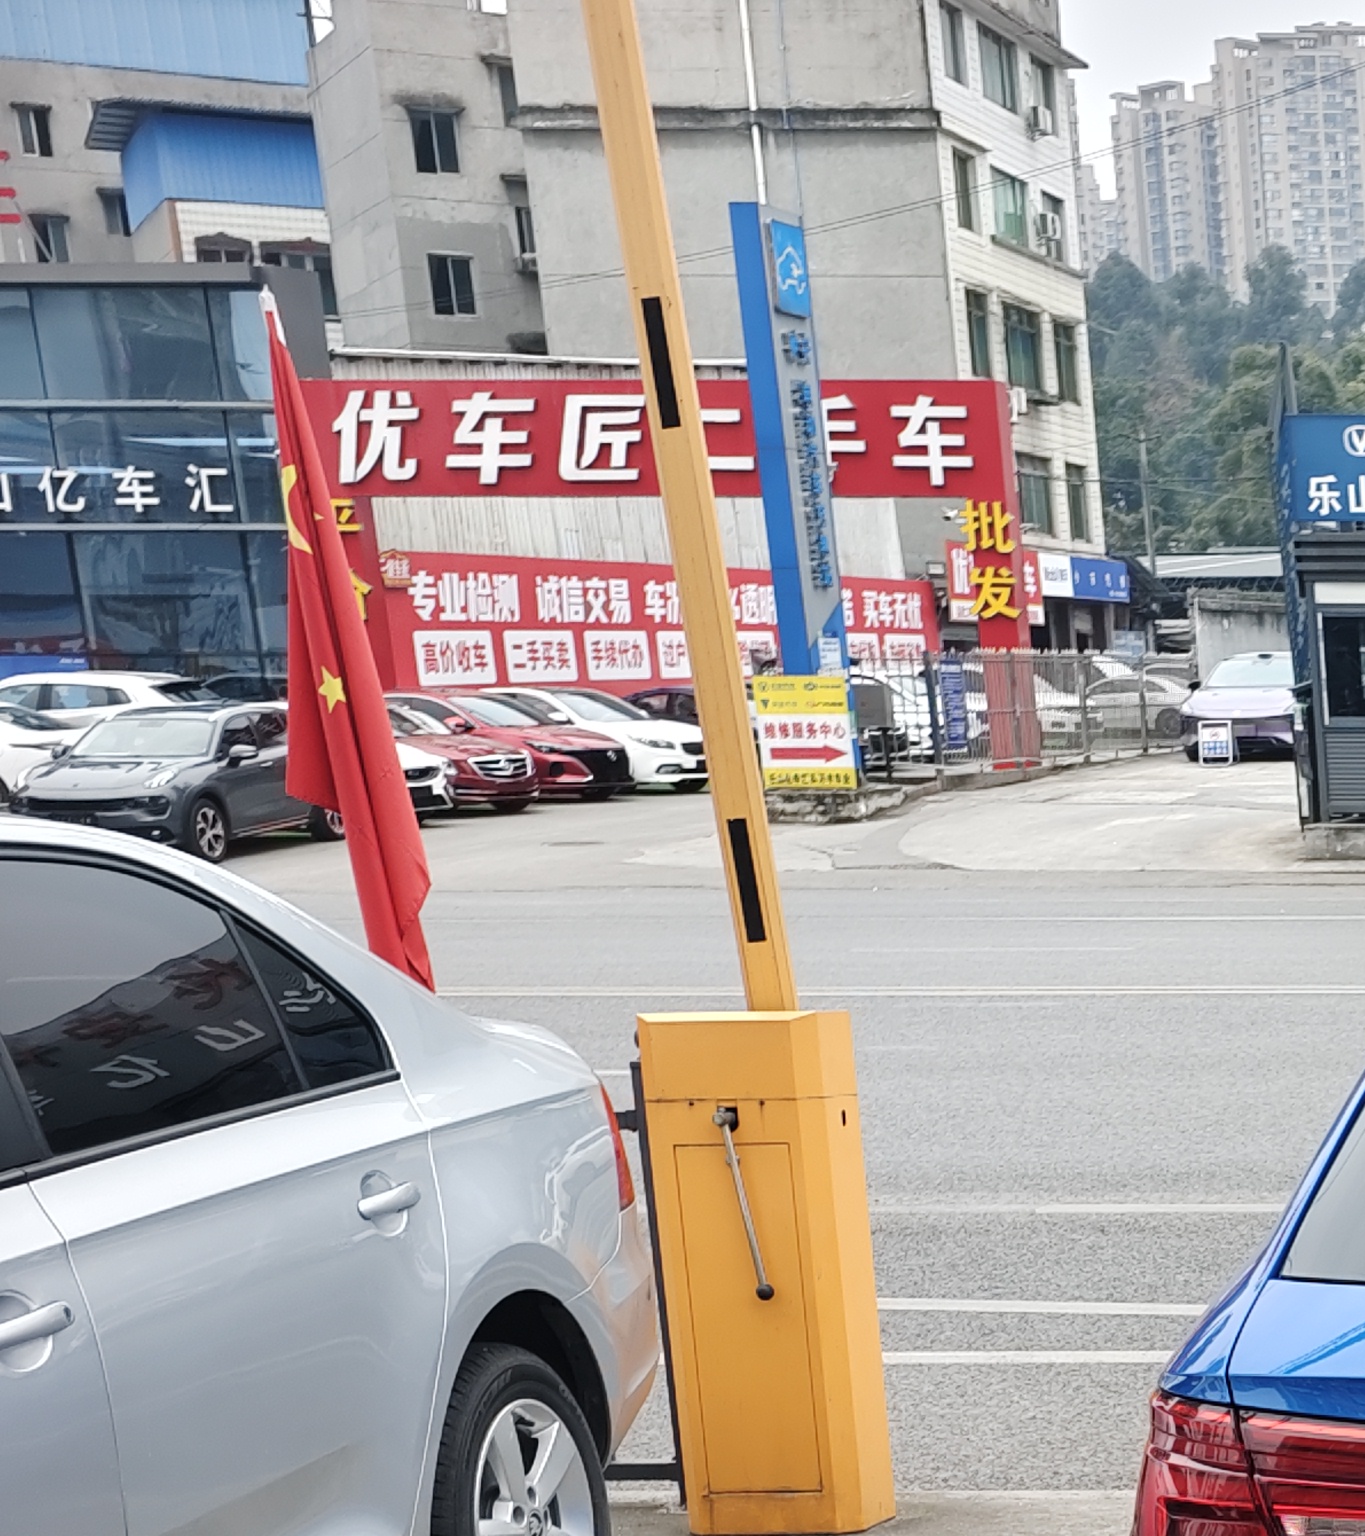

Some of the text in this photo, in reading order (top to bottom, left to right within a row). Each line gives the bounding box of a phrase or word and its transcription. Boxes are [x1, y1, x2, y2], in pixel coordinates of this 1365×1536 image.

[0, 465, 234, 514] 亿车汇
[960, 498, 1022, 619] 批发
[407, 570, 521, 622] 专业检测
[535, 575, 632, 624] 诚信交易
[421, 639, 489, 674] 高价收车
[512, 640, 572, 671] 二手买卖
[590, 639, 645, 671] 手续代办
